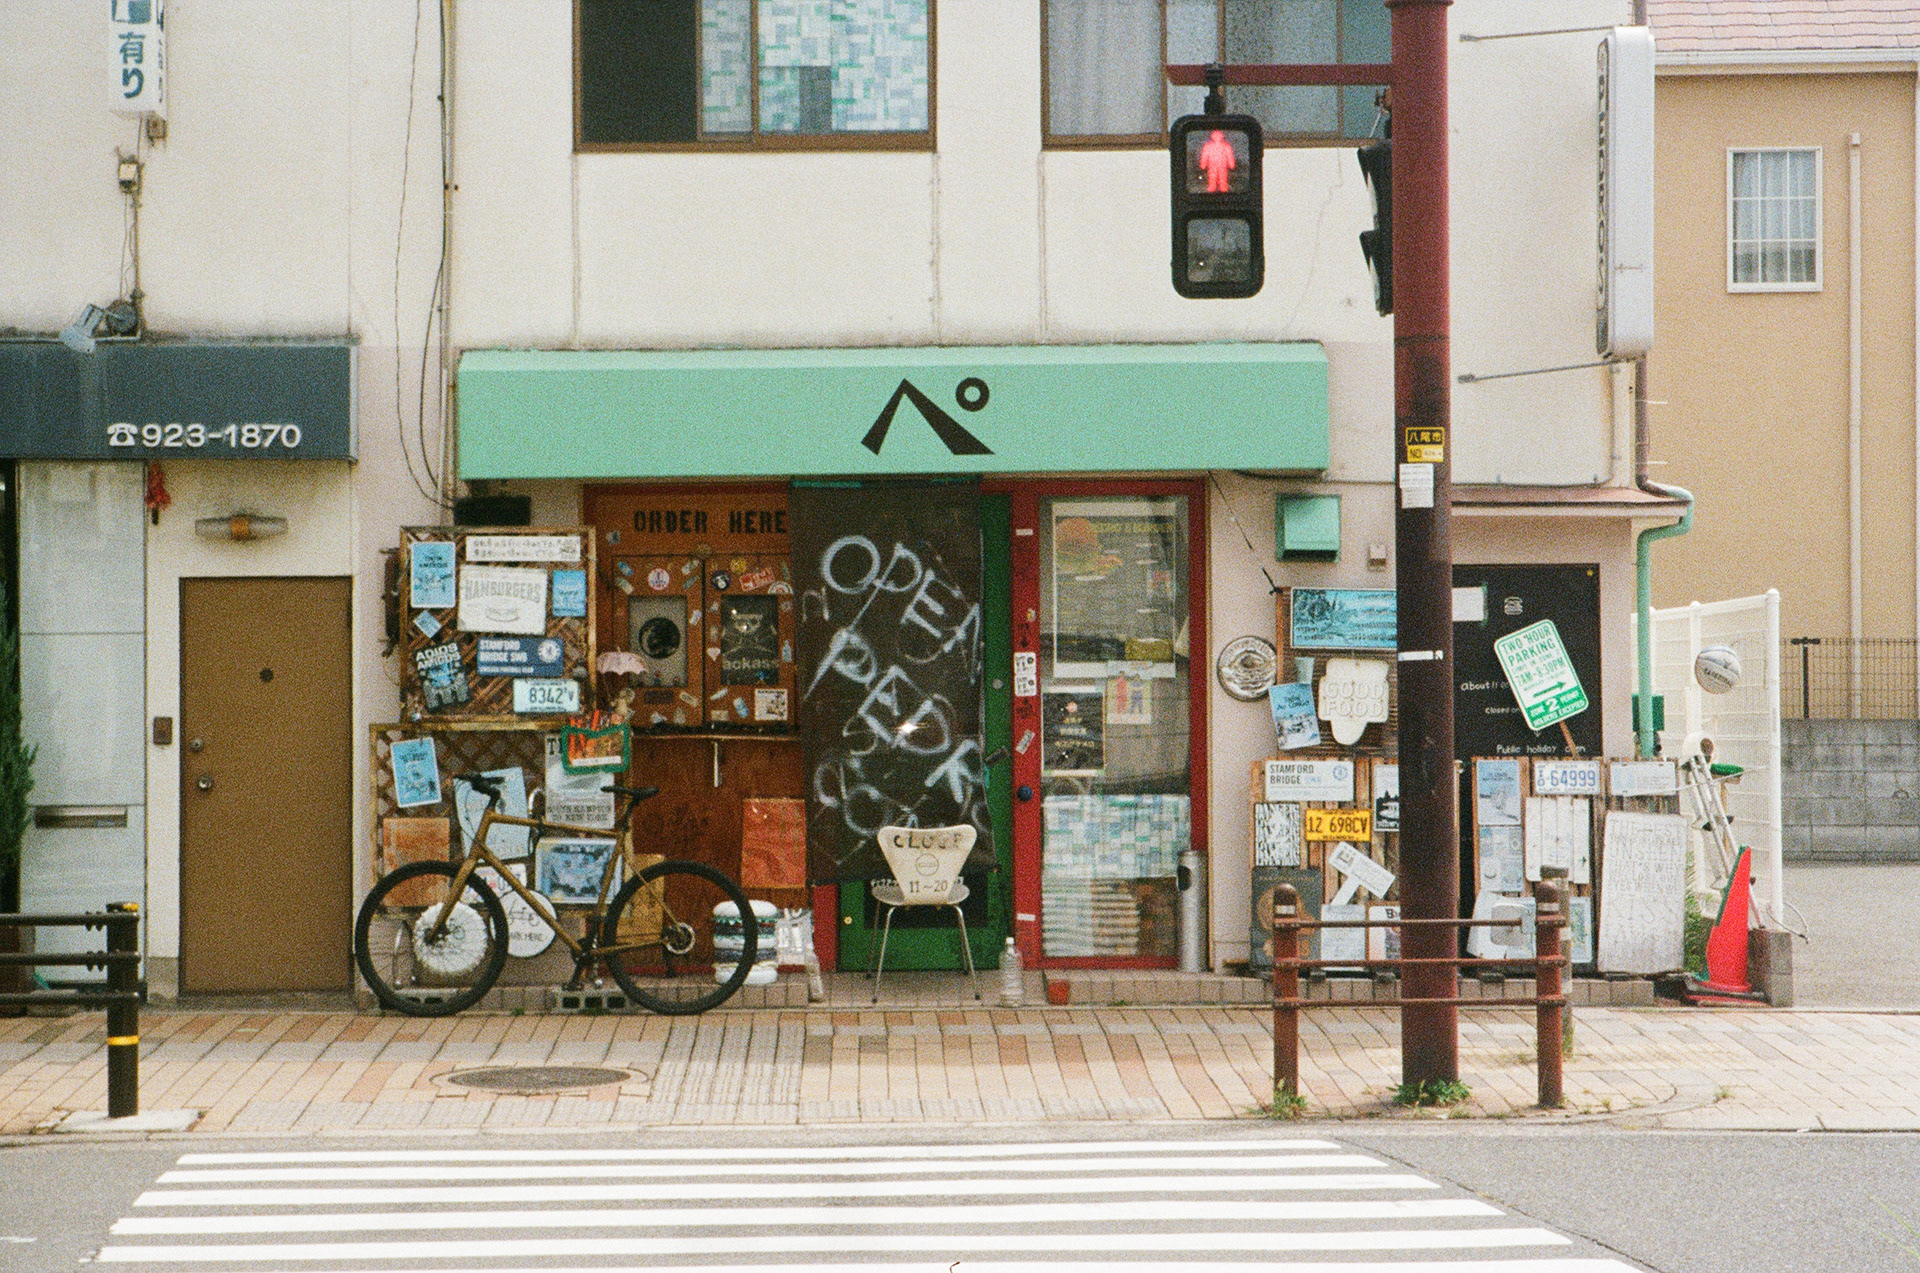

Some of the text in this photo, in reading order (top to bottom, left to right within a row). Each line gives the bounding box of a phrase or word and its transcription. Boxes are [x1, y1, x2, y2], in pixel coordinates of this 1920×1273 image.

[142, 424, 302, 449] 923-1870
[633, 510, 788, 534] ORDER HERE
[464, 580, 541, 604] HAMBURGERS
[416, 642, 459, 662] ADIOS
[1508, 638, 1556, 665] PARKING
[1324, 682, 1386, 699] GOOD
[1324, 700, 1386, 717] FOOD
[1544, 696, 1560, 713] 2
[1269, 764, 1314, 775] STAMFORD
[1269, 775, 1302, 785] BRIDGE
